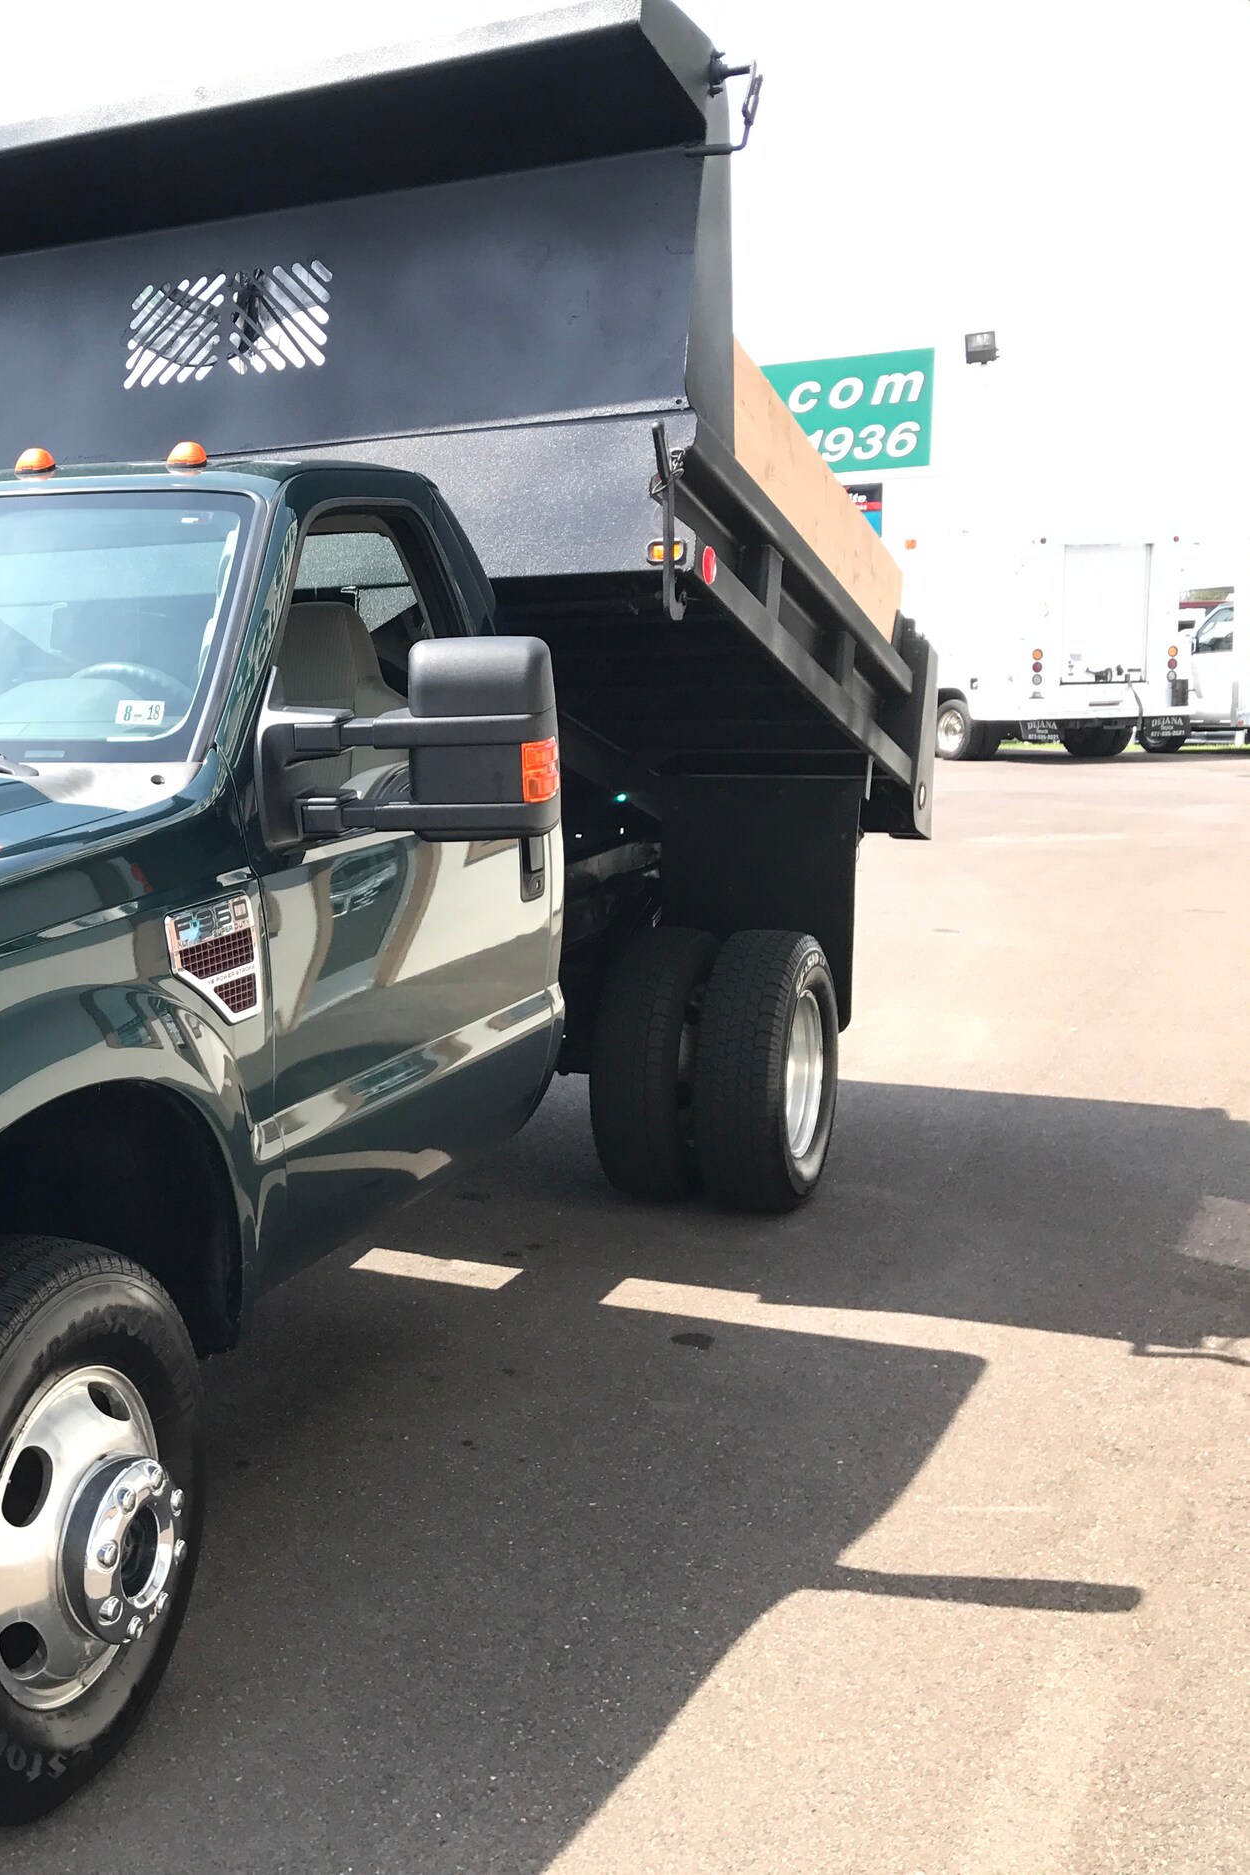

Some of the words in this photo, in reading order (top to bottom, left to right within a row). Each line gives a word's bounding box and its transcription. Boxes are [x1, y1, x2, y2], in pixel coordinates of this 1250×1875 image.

[212, 924, 233, 937] SUPER
[234, 919, 250, 931] DUTY
[215, 971, 235, 982] POWER
